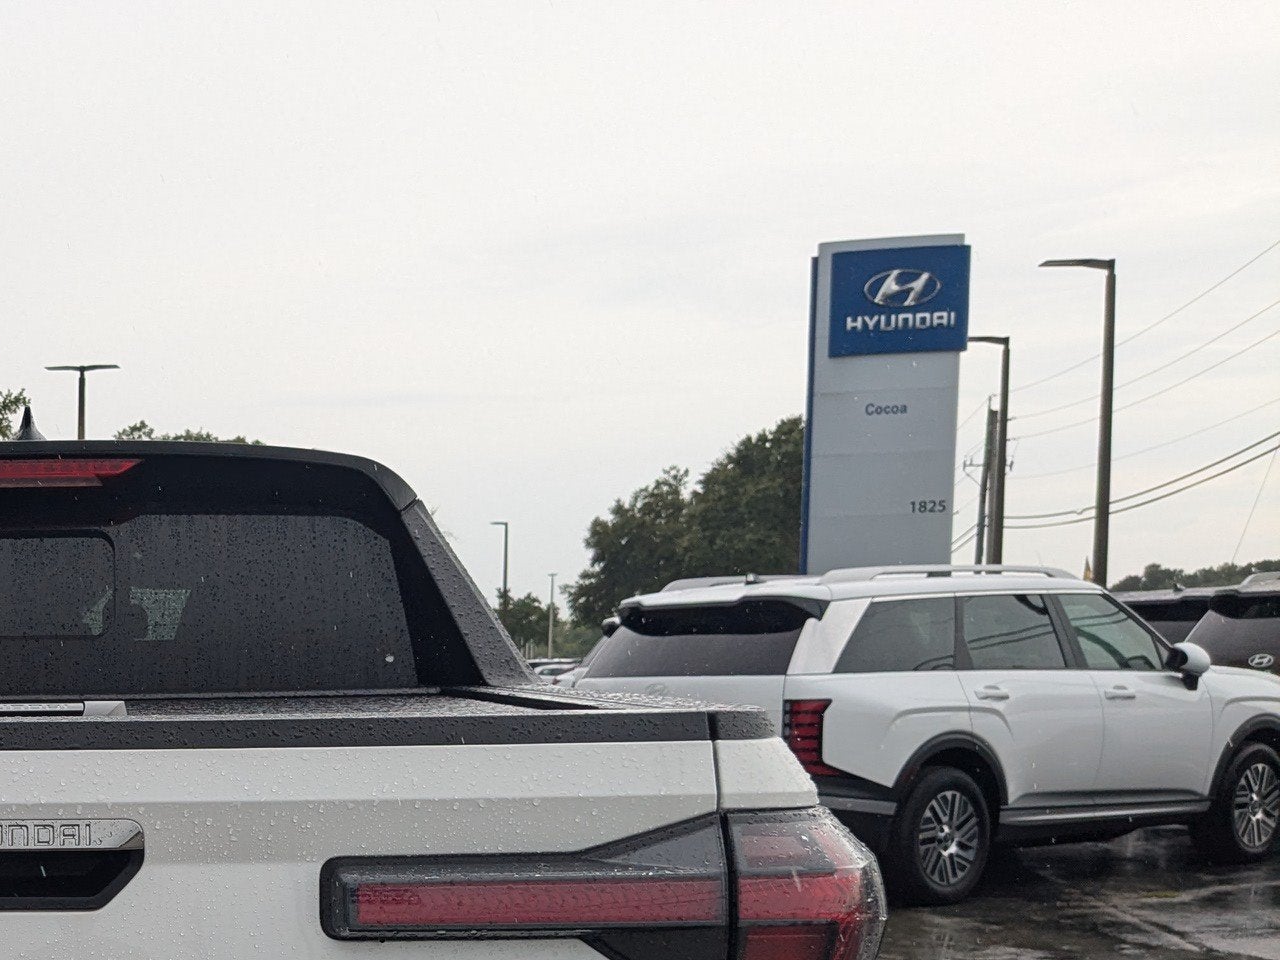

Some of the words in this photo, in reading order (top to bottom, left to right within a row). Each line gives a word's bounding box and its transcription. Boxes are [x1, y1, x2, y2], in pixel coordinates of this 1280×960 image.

[846, 310, 956, 332] HYUNDAI
[865, 403, 908, 416] Cocoa
[910, 500, 946, 513] 1825
